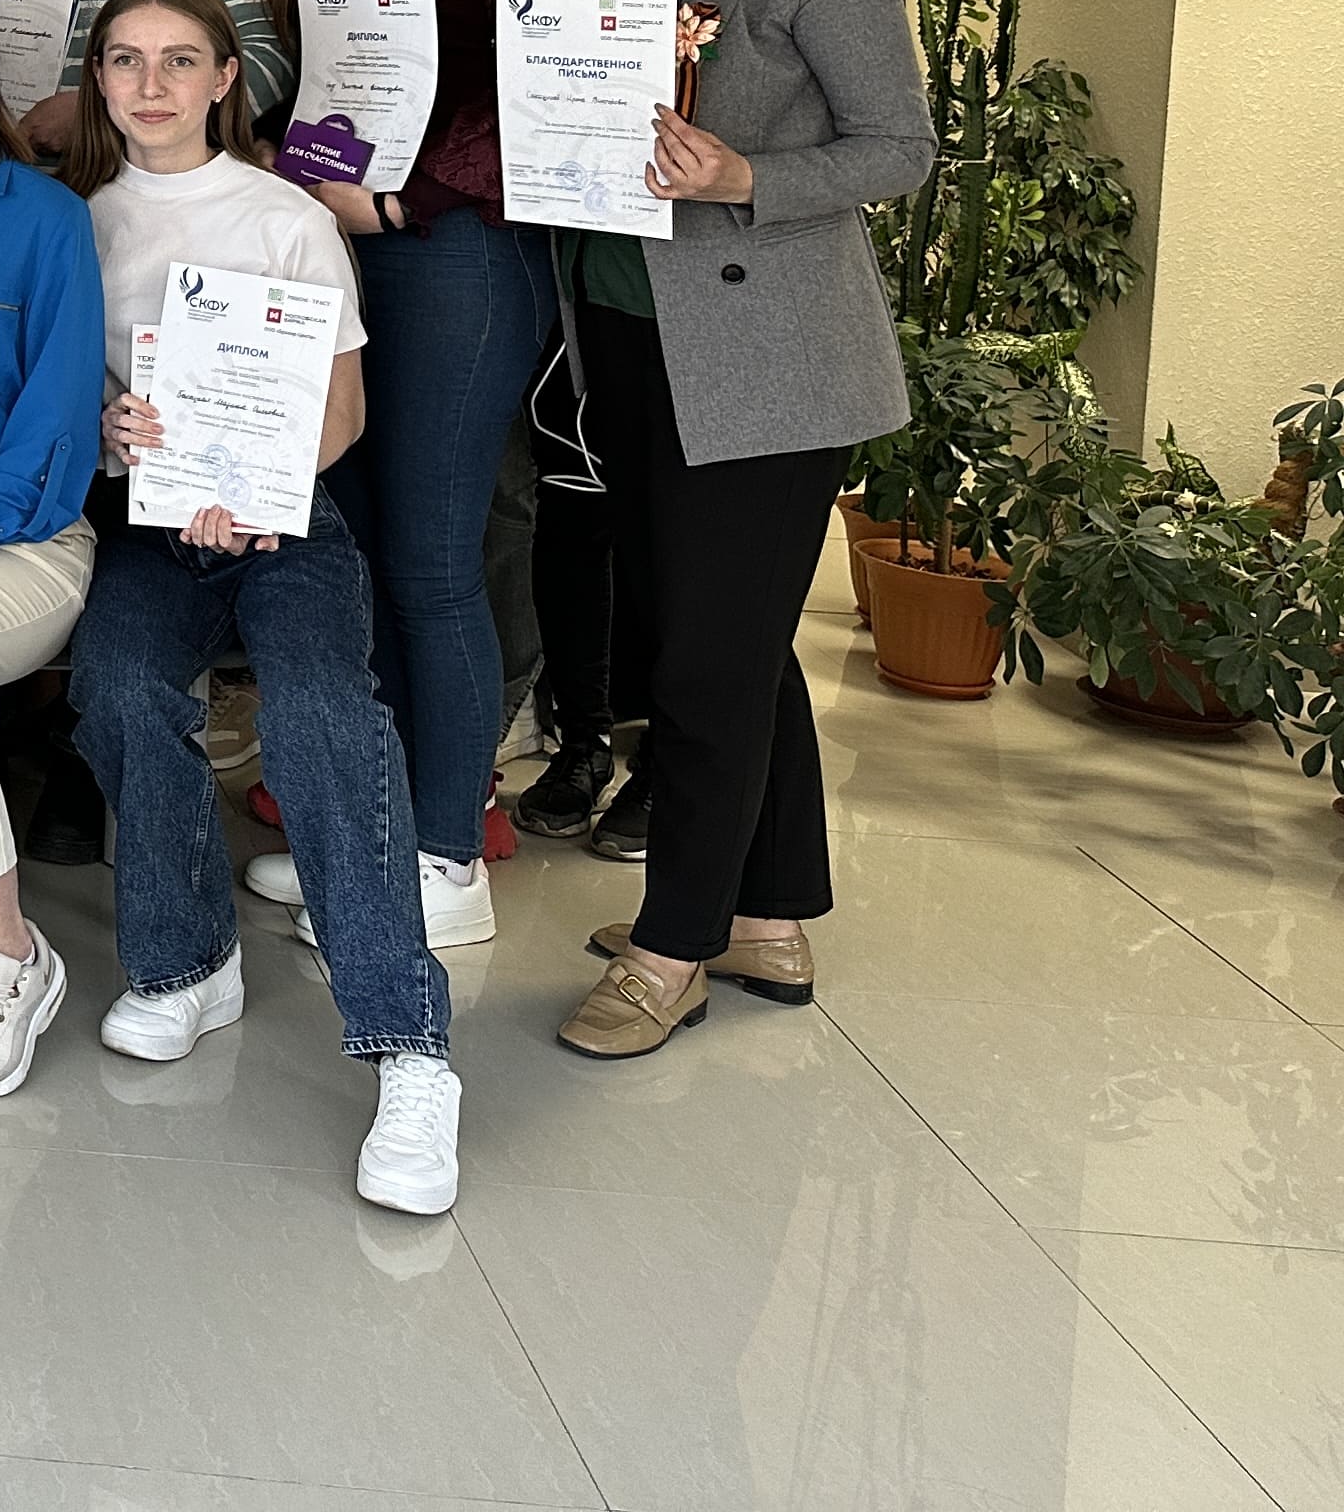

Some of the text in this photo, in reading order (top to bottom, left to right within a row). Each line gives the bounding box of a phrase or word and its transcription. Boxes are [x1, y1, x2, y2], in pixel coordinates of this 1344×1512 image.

[521, 15, 562, 26] СКФУ
[347, 32, 388, 41] ДИПЛОМ
[526, 55, 642, 70] БЛАГОДАРСТВЕННОЕ
[558, 69, 607, 80] ПИСЬМО
[311, 142, 342, 159] ЧТЕНИЕ
[286, 146, 358, 175] ДЛЯ СЧАСТЛИВЫХ
[189, 297, 230, 312] СКФУ
[217, 342, 269, 359] ДИПЛОМ
